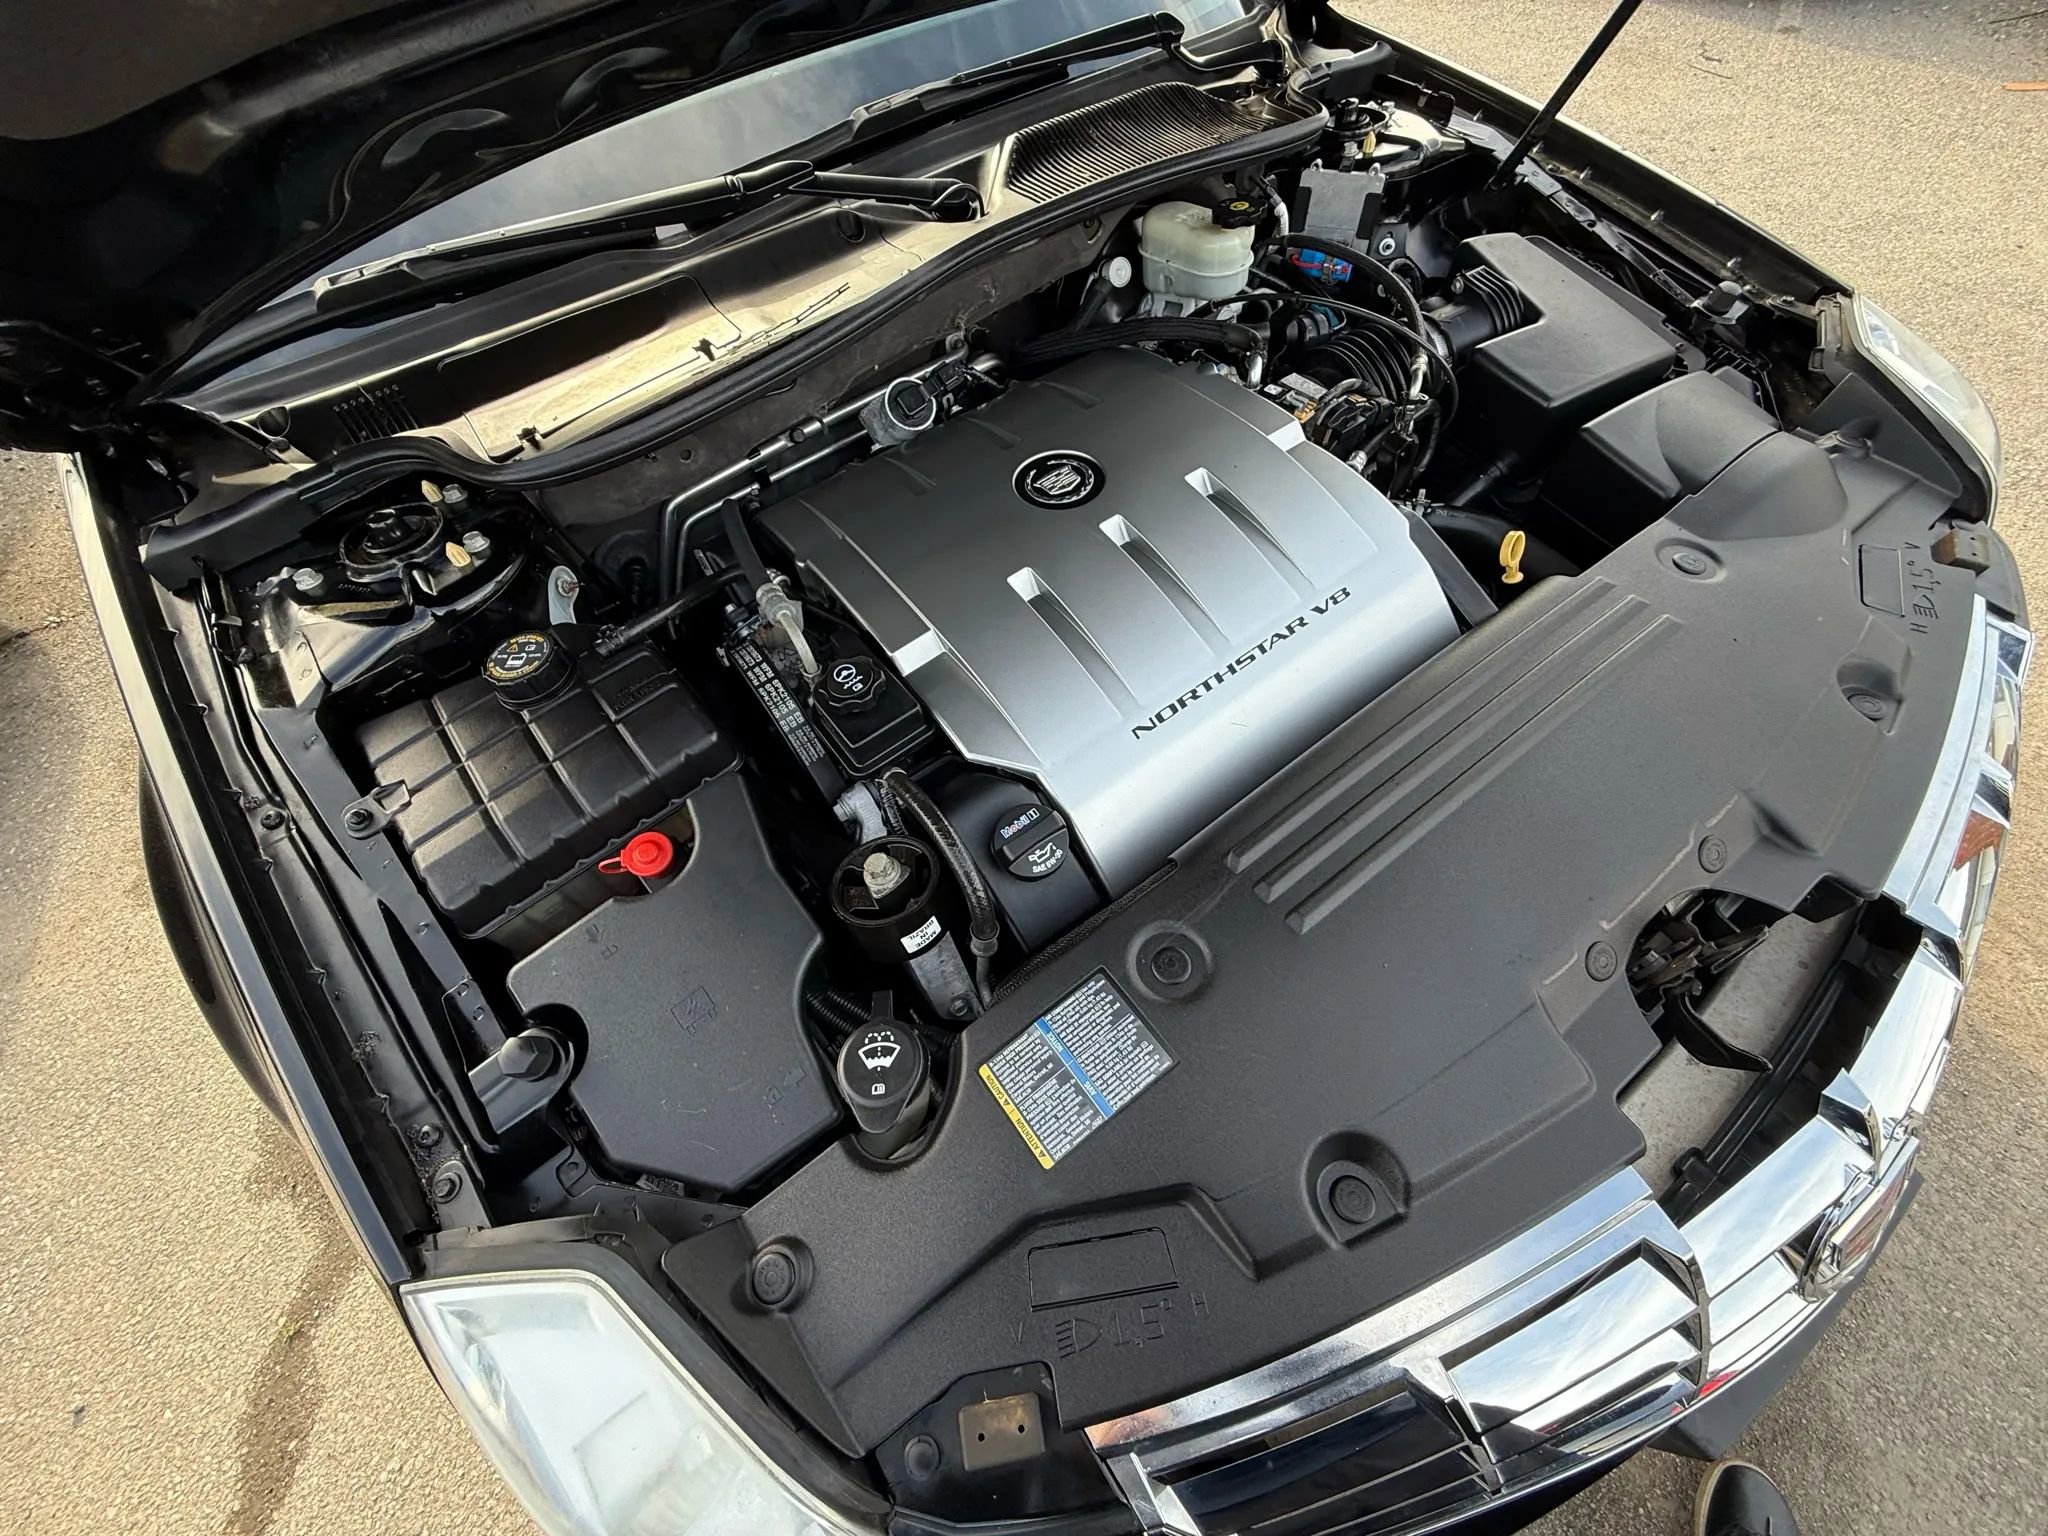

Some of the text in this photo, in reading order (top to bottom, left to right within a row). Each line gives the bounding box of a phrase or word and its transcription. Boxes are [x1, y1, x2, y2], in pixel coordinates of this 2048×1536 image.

[1131, 586, 1351, 740] NORTHSTAR V8
[760, 661, 774, 678] WFM
[771, 677, 796, 710] 6PK2105
[793, 710, 805, 724] EB
[764, 682, 788, 715] 6PK2105
[785, 715, 797, 728] EB
[778, 719, 790, 732] EB
[1000, 812, 1030, 839] Mobil
[1032, 863, 1047, 873] SAE
[908, 919, 935, 941] BRAZIL
[916, 930, 938, 949] MADE
[920, 931, 929, 940] IN
[1046, 1030, 1064, 1052] NOTICE
[984, 1073, 1005, 1100] CAUTION
[1083, 1080, 1097, 1096] AVIS
[1015, 1117, 1040, 1150] ATTENTION
